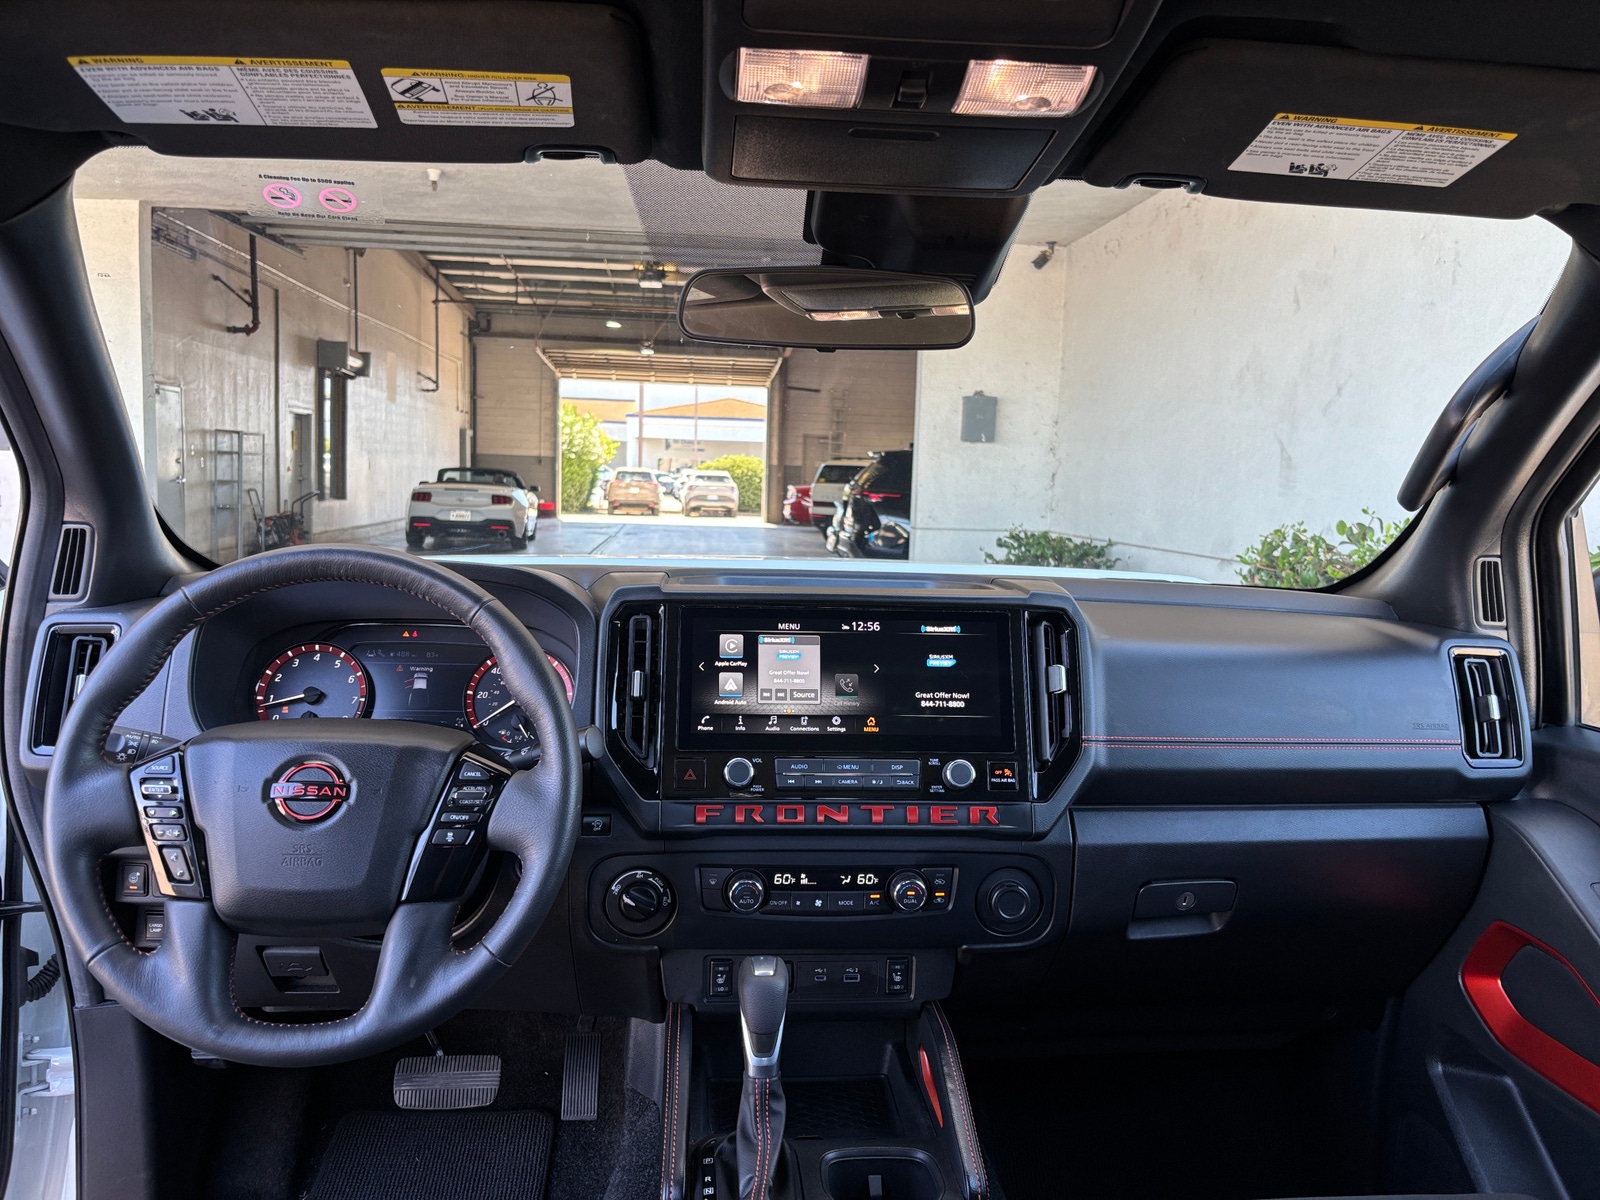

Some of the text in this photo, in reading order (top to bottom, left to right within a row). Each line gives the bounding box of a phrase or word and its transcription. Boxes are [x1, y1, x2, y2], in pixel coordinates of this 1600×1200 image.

[1293, 115, 1338, 124] WARNING
[1427, 126, 1502, 138] AVERTISSEMENT
[852, 622, 880, 631] 12:56
[292, 659, 299, 668] 3
[334, 660, 341, 668] 5
[275, 674, 282, 682] 2
[348, 676, 355, 684] 6
[274, 786, 346, 796] NISSAN
[694, 805, 999, 824] FRONTIER
[292, 844, 312, 853] SRS
[281, 857, 323, 866] AIRBAG
